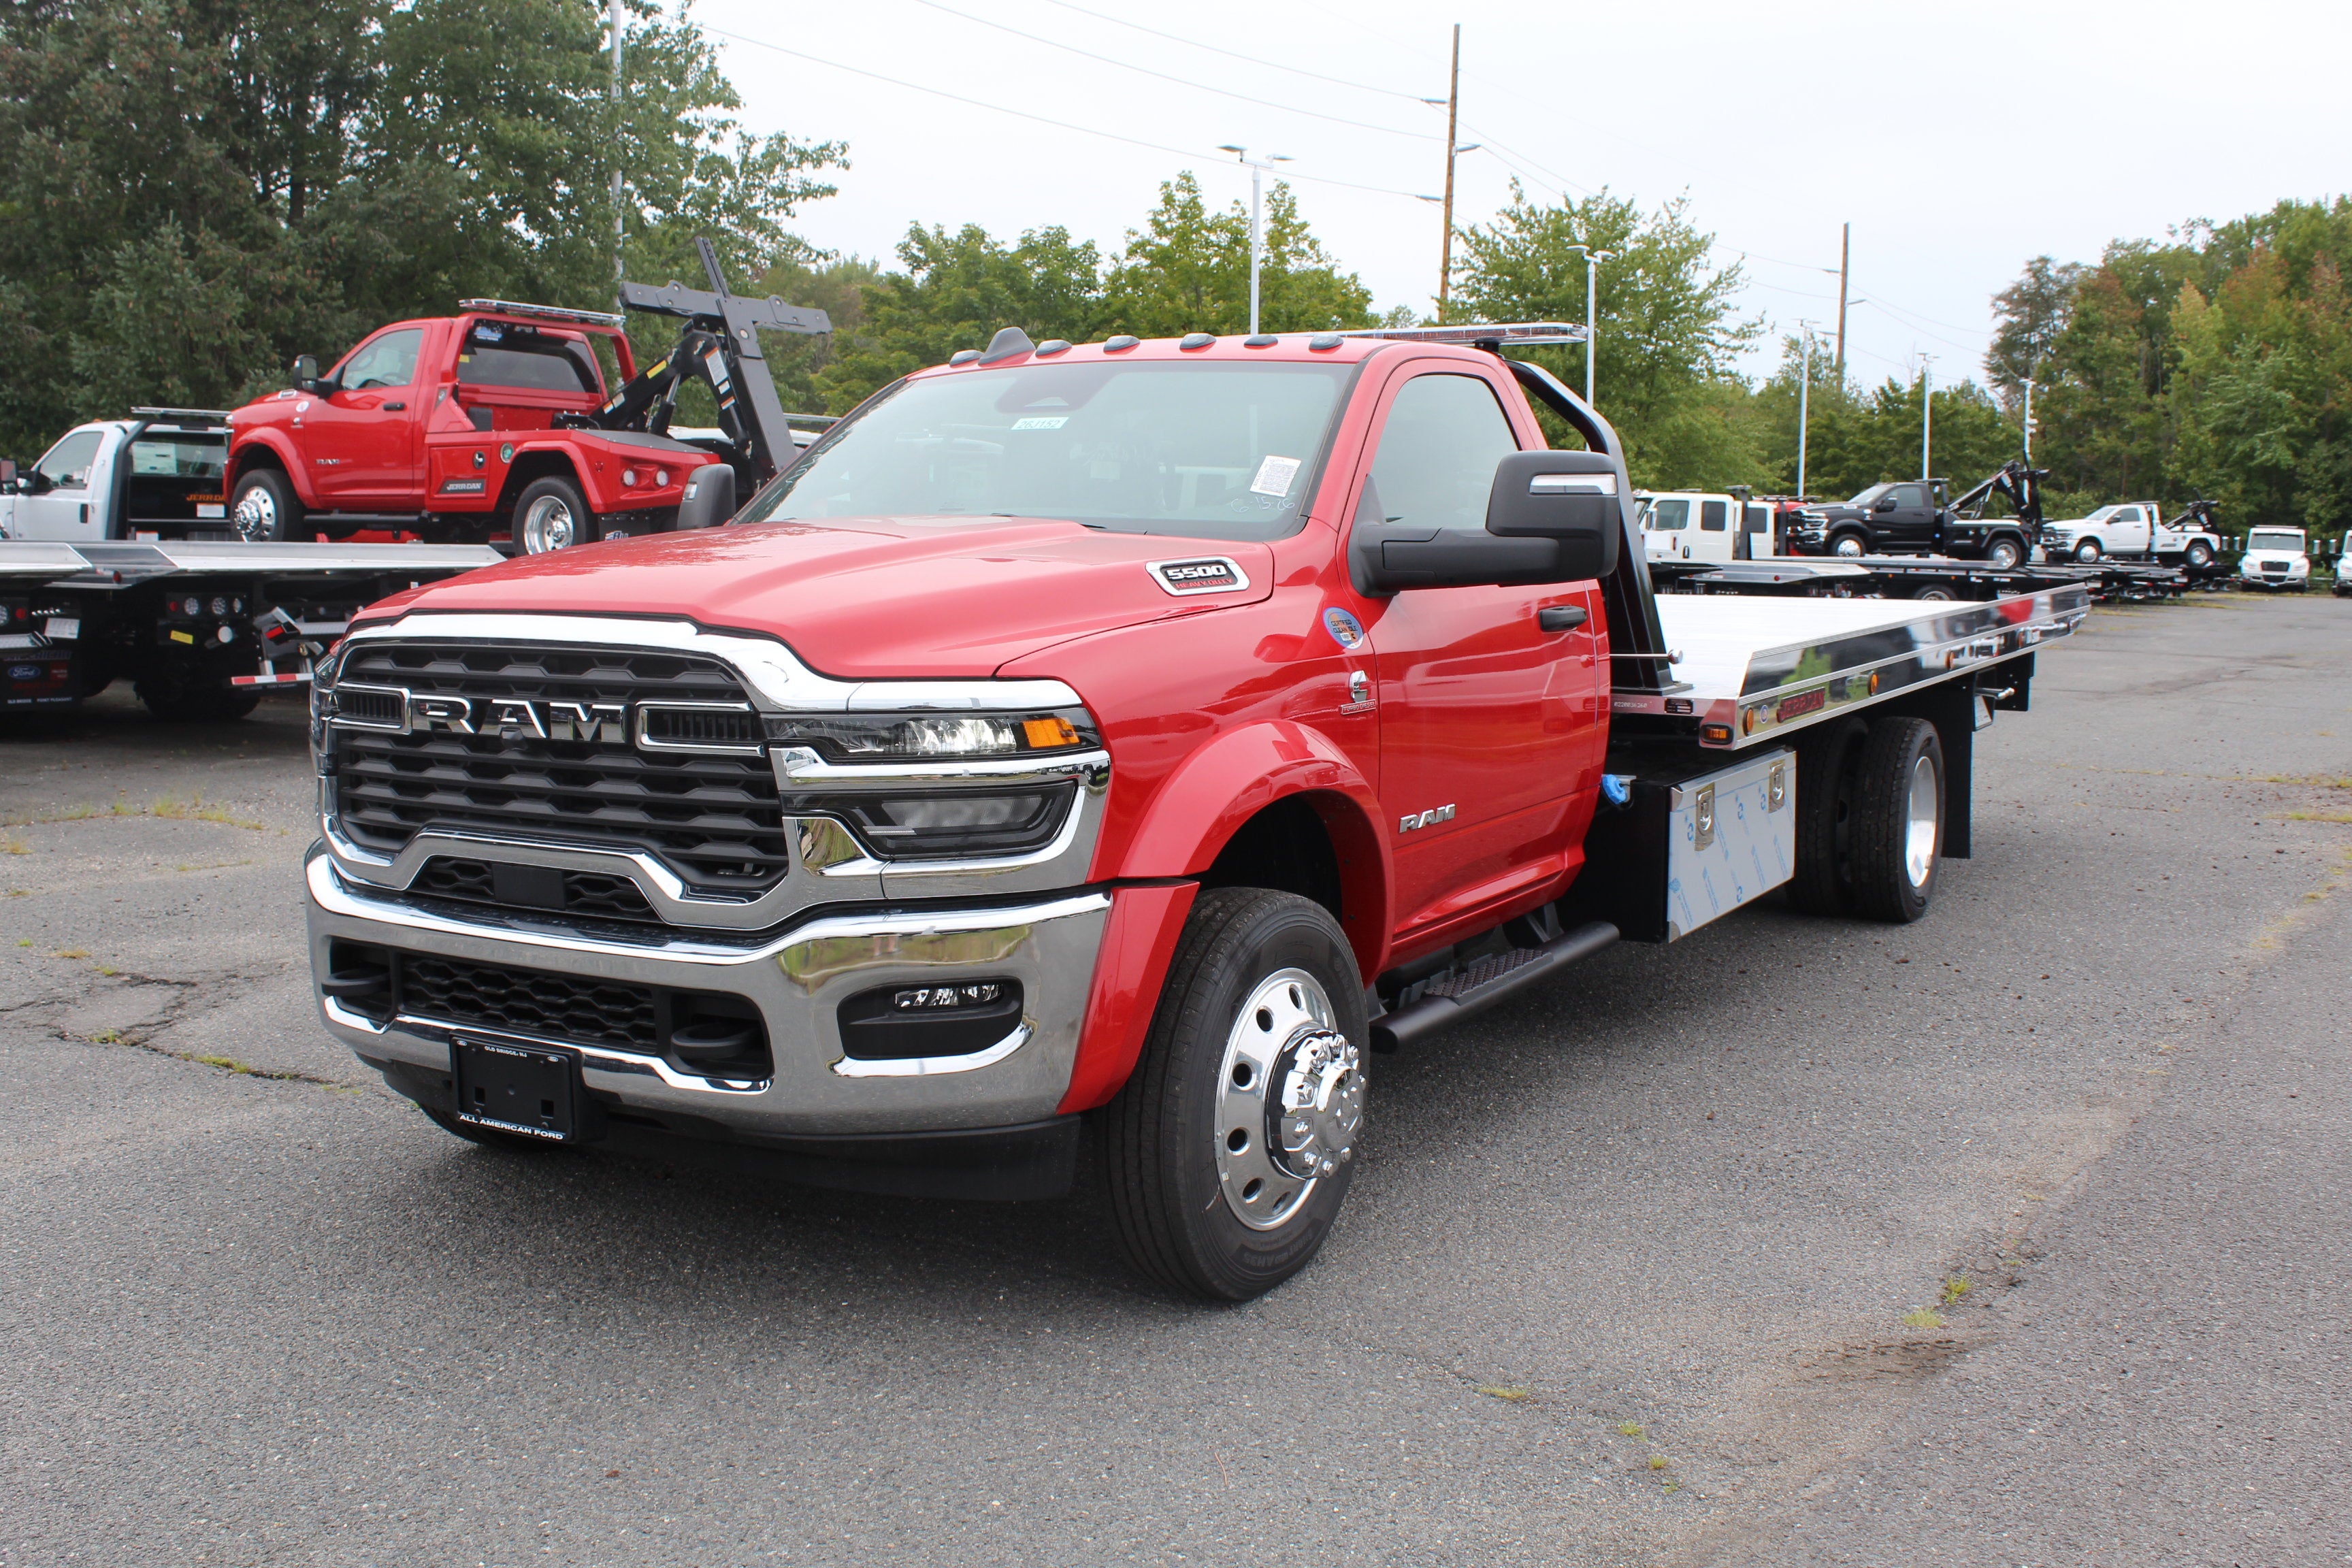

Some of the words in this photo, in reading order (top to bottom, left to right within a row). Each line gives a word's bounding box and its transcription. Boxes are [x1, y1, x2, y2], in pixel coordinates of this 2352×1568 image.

[1017, 420, 1060, 429] 26J152
[1166, 564, 1227, 581] 5500
[410, 693, 627, 744] RAM
[1399, 803, 1456, 834] RAM
[459, 1114, 478, 1124] ALL
[479, 1118, 532, 1135] AMERICAN
[534, 1128, 564, 1141] FORD
